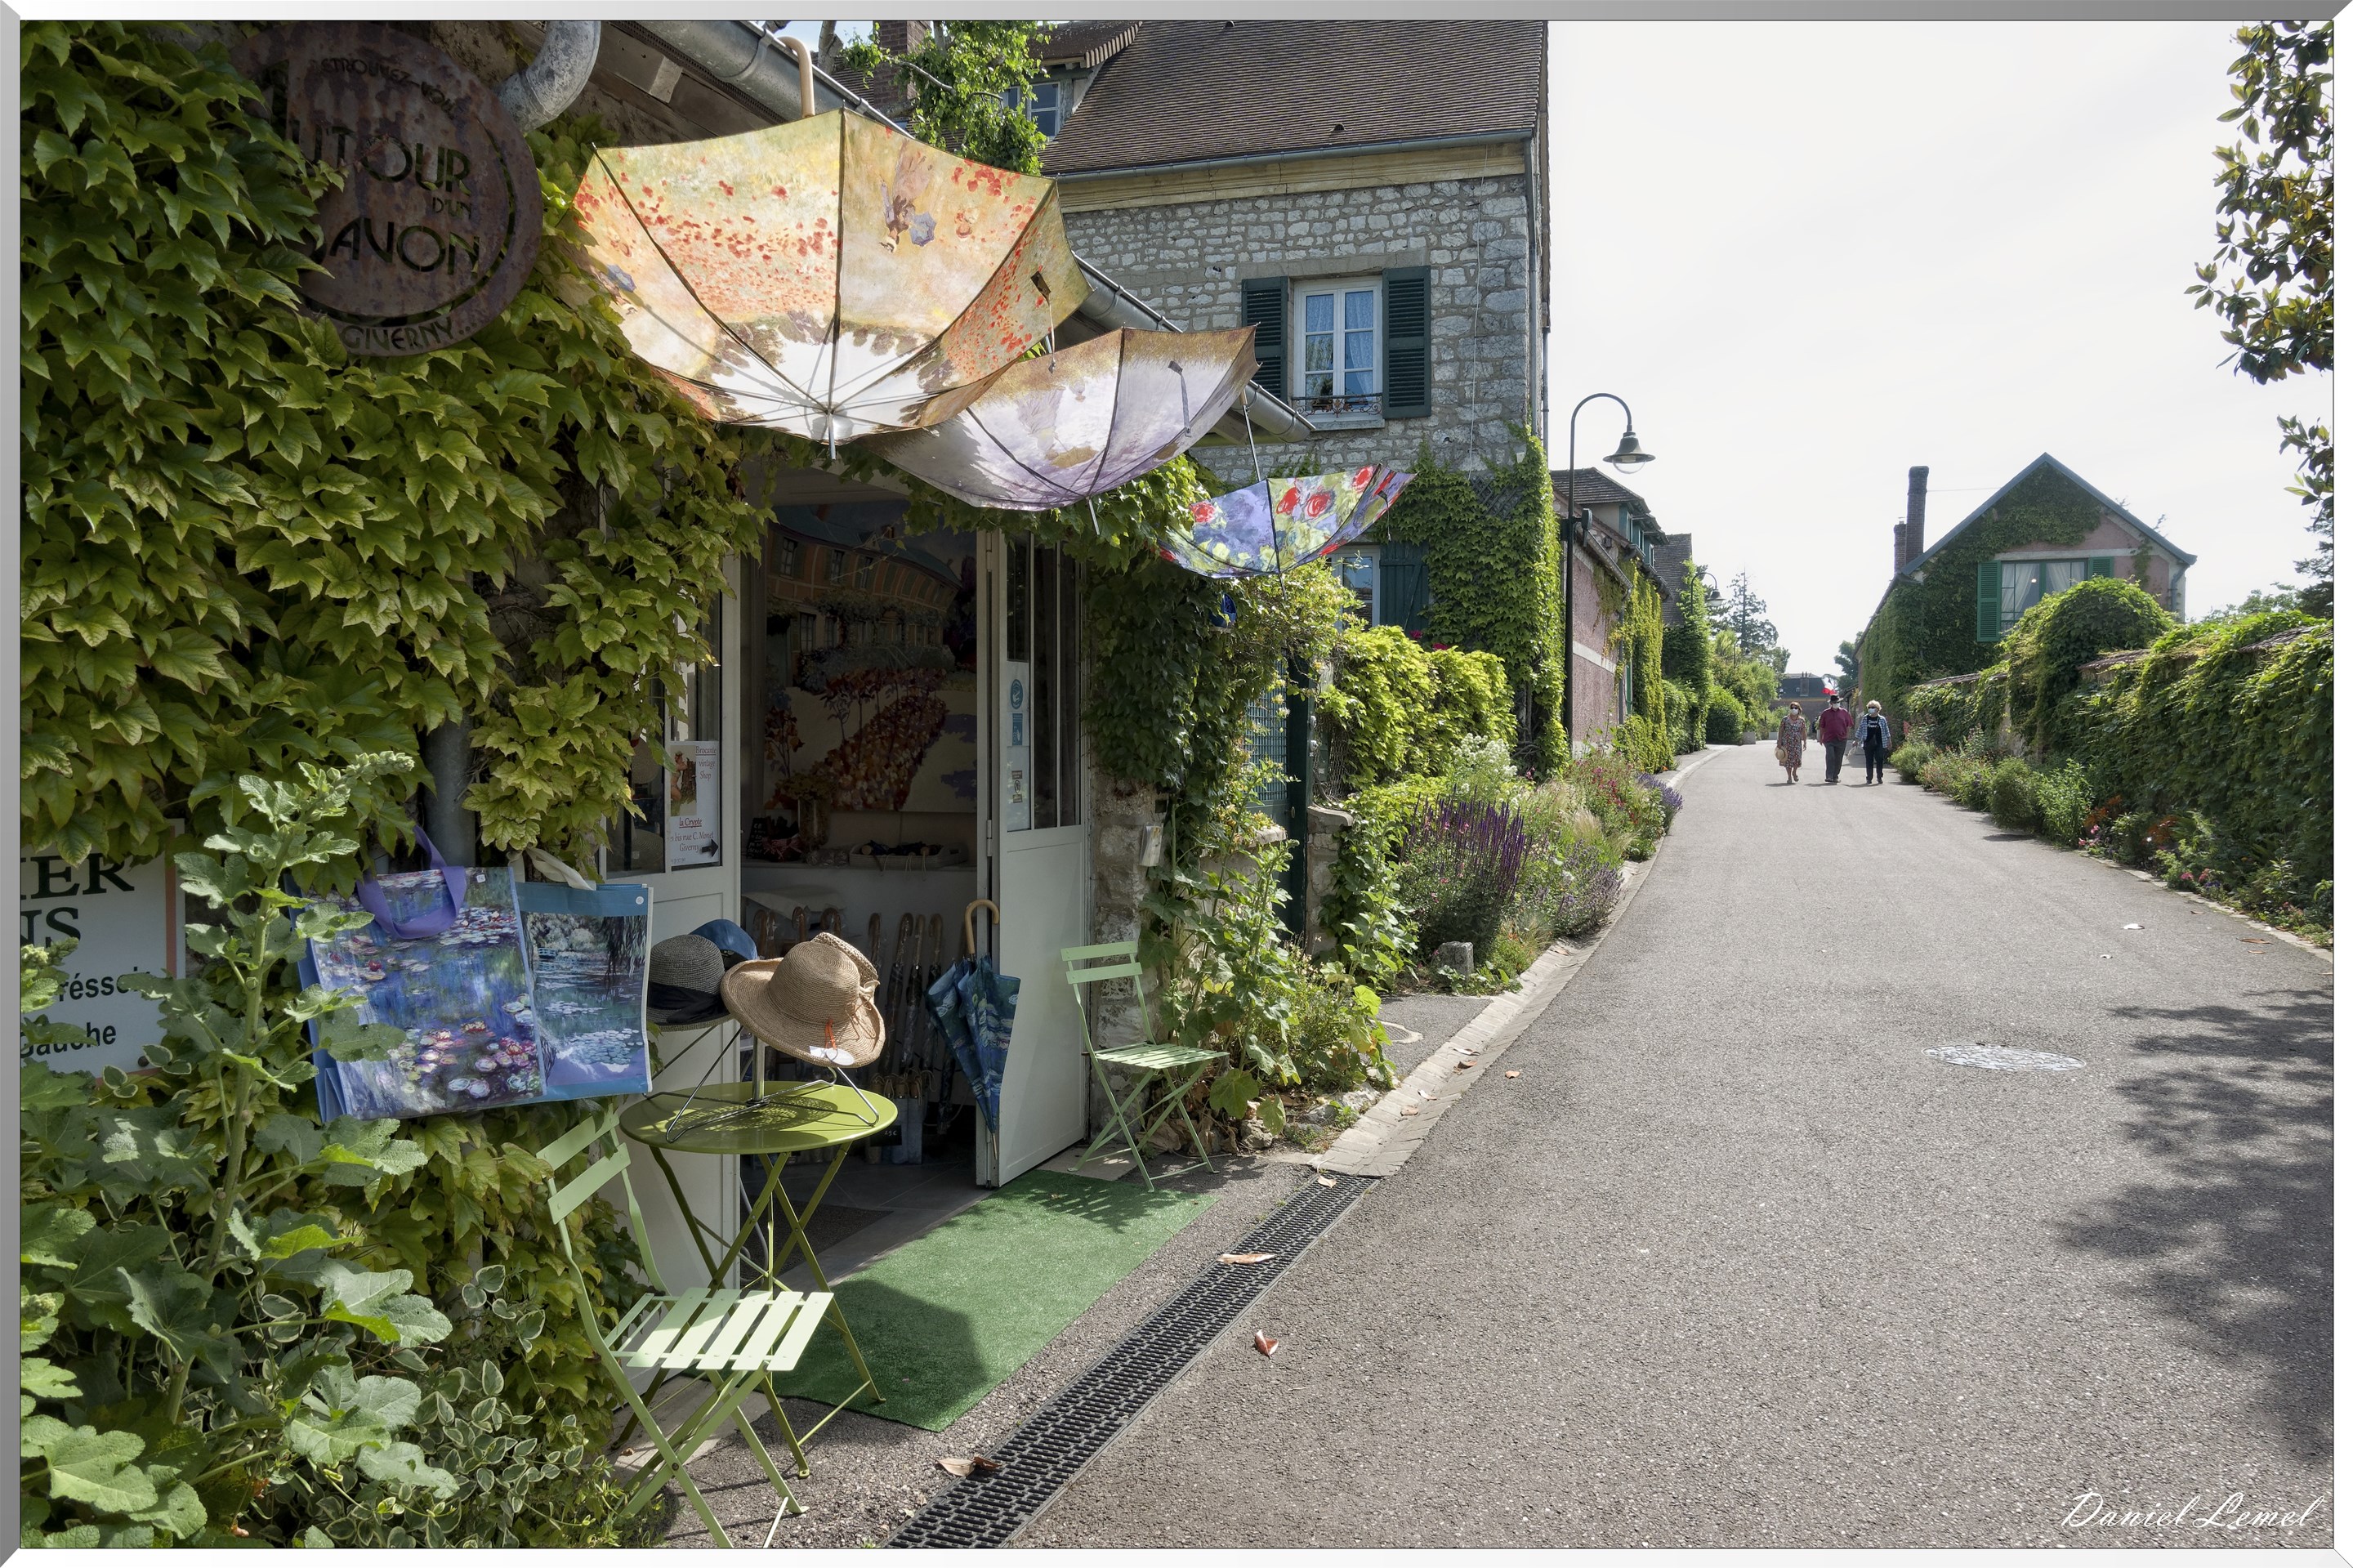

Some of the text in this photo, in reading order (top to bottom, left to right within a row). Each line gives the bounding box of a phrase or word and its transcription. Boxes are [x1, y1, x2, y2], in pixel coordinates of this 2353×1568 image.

[699, 759, 716, 770] vintage
[699, 771, 712, 780] Shop
[699, 830, 714, 839] Monet
[680, 842, 700, 853] Giverny
[20, 852, 135, 900] ER
